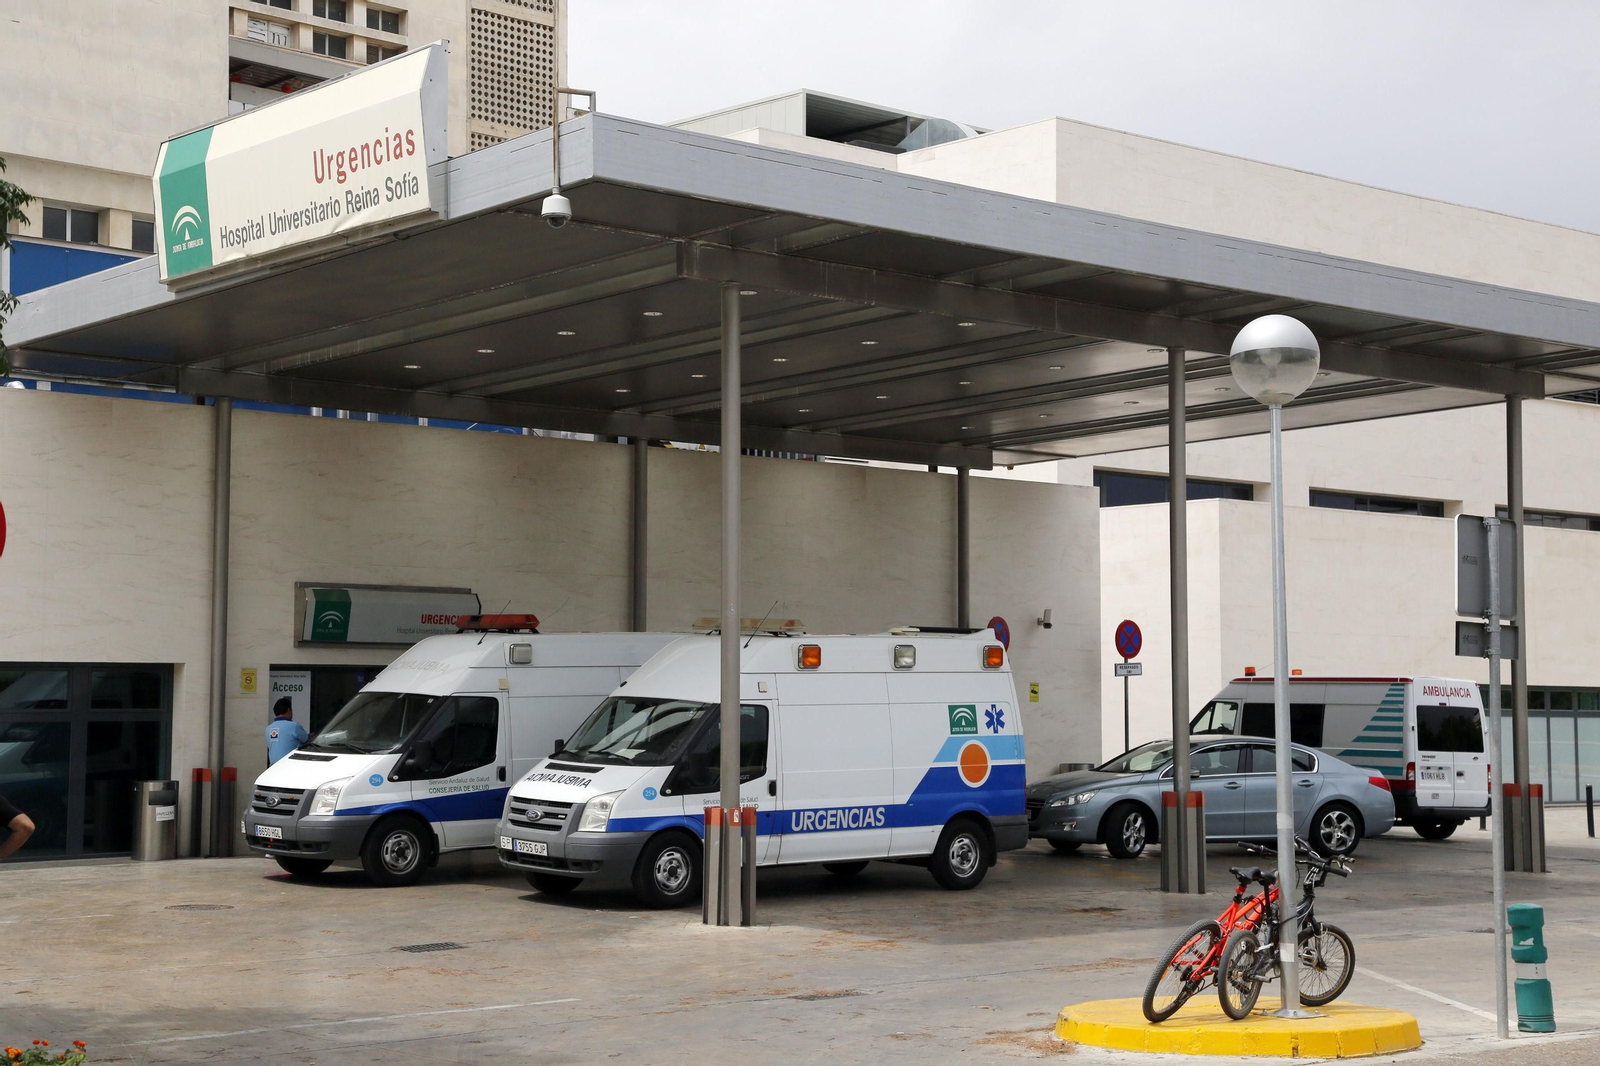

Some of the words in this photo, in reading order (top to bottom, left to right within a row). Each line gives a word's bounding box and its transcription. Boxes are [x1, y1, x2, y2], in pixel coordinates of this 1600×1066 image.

[313, 127, 417, 184] Urgencias
[219, 215, 265, 248] Hospital
[268, 196, 341, 235] Universitario
[345, 186, 380, 213] Reina
[385, 172, 419, 203] Sofía
[421, 614, 459, 625] URGENC
[396, 627, 415, 635] Hospital
[272, 681, 303, 692] Acceso
[1423, 685, 1472, 698] AMBULANCIA
[1424, 772, 1435, 780] 1061
[428, 785, 463, 794] CONSEJERÍA
[791, 807, 886, 832] URGENCIAS
[501, 837, 511, 848] SP
[518, 841, 533, 853] 3755
[534, 843, 546, 854] GJP
